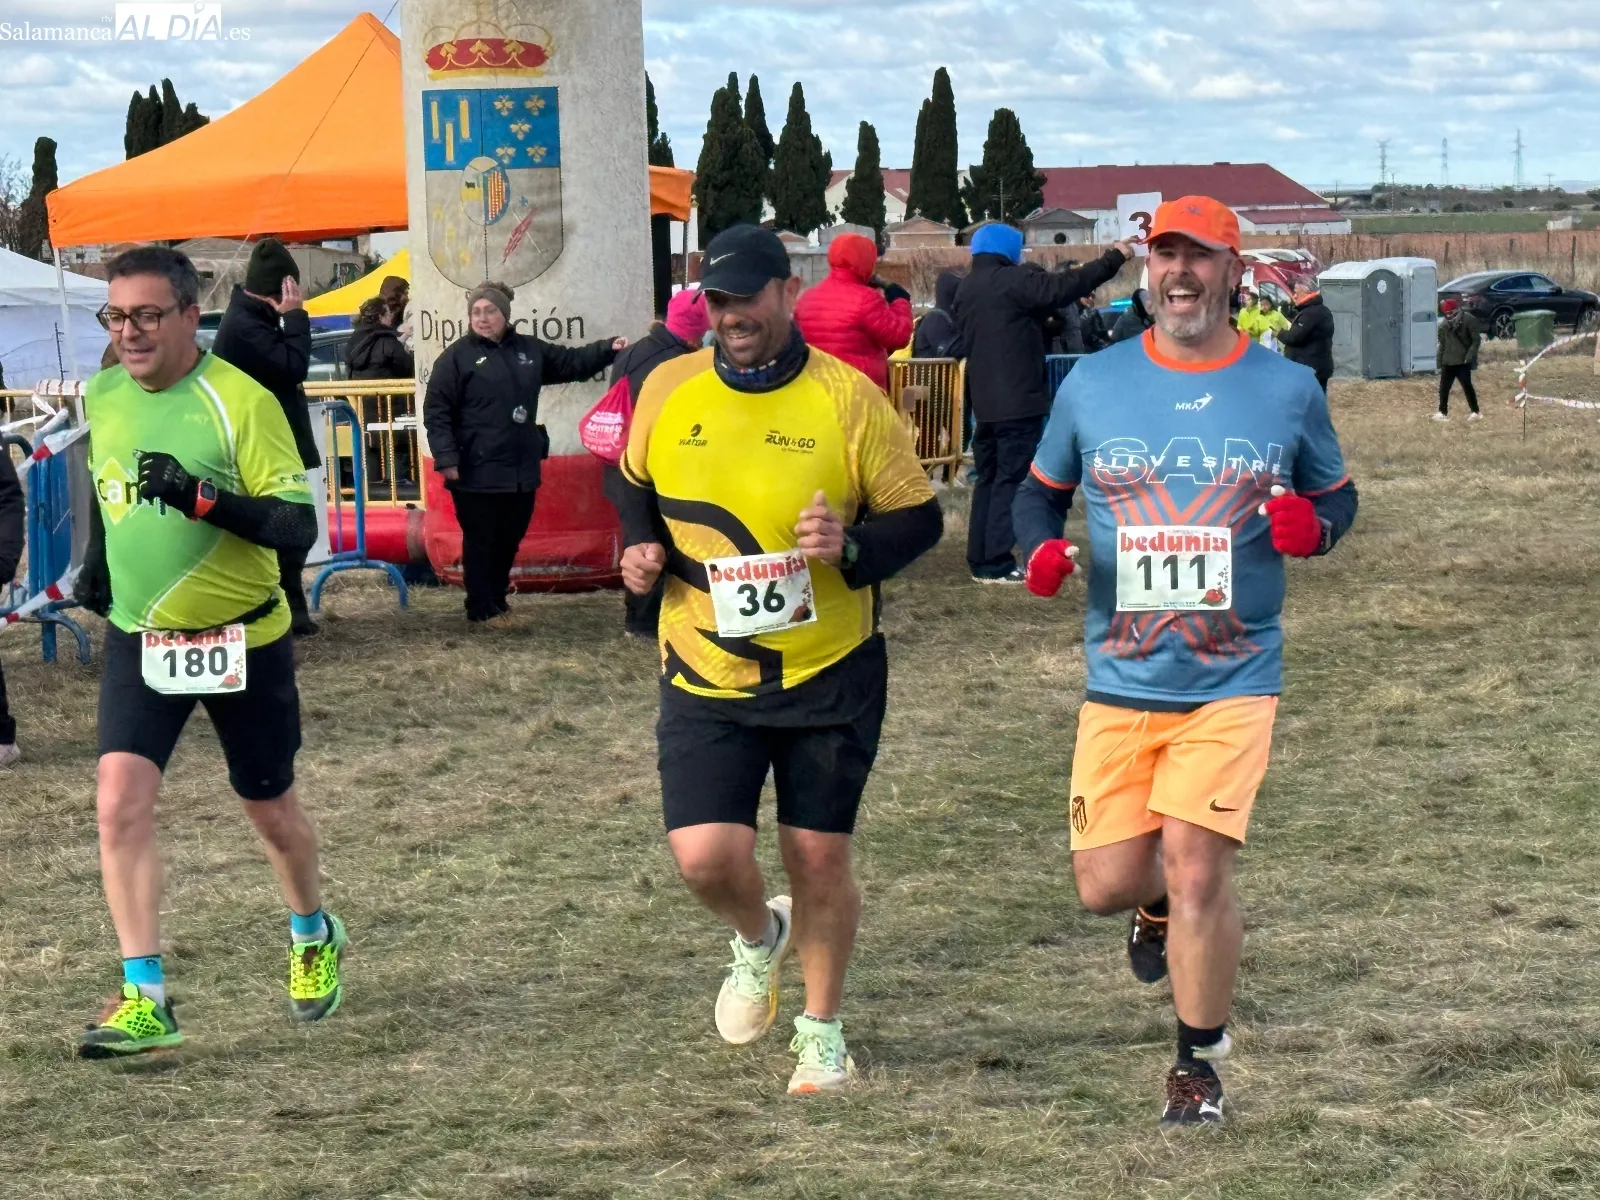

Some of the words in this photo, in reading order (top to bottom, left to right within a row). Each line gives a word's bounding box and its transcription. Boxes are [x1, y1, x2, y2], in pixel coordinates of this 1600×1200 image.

[1120, 531, 1228, 552] bedunia
[1137, 554, 1206, 590] 111
[737, 580, 785, 616] 36
[163, 646, 228, 677] 180
